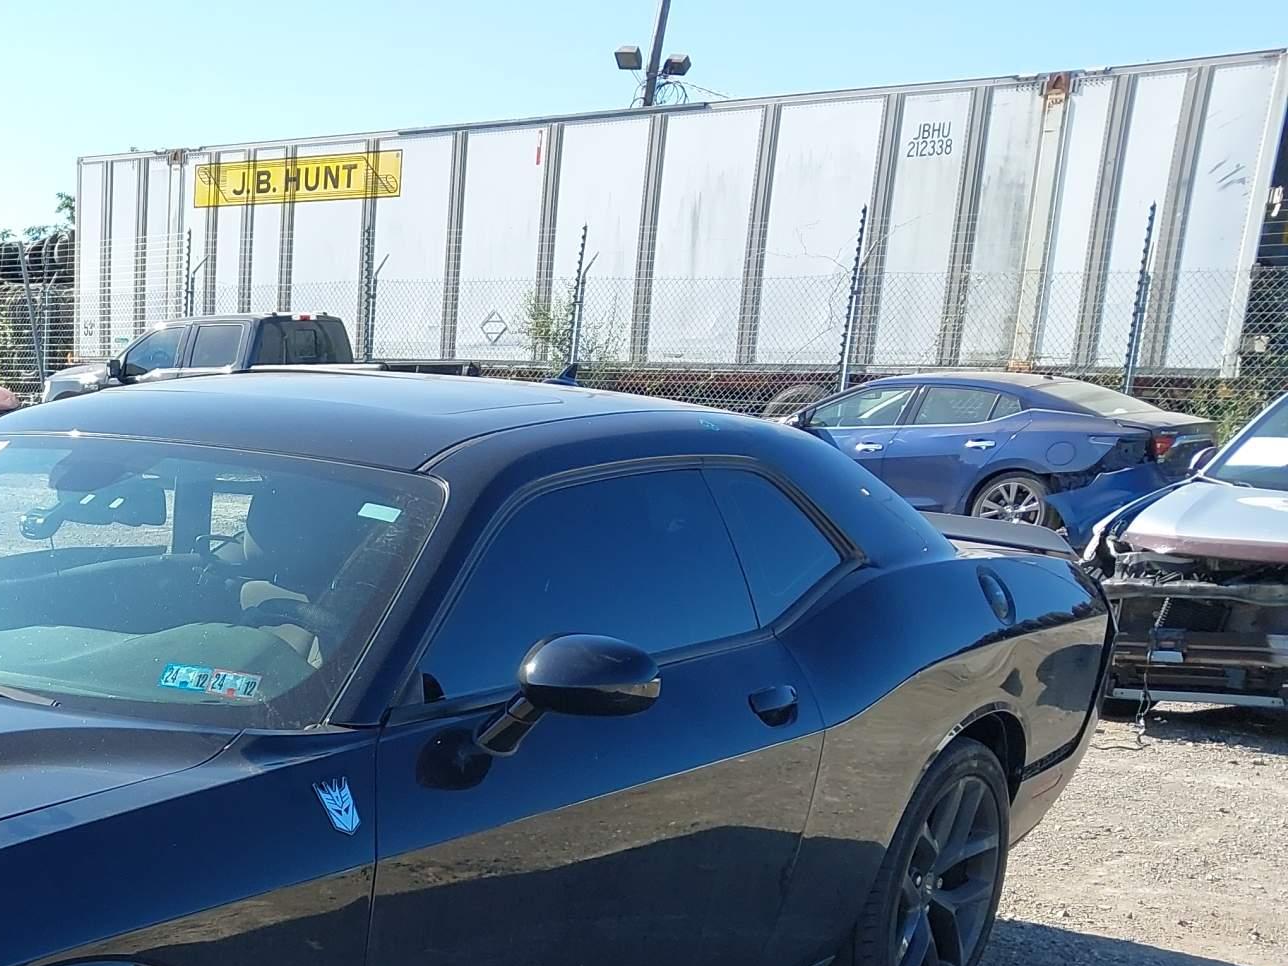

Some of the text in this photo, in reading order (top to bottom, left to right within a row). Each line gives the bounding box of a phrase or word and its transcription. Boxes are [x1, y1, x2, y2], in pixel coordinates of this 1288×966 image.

[913, 121, 951, 140] JBHU
[907, 138, 953, 157] 212338
[284, 163, 358, 193] HUNT
[164, 667, 209, 688] 24 12
[211, 673, 257, 697] 24 12
